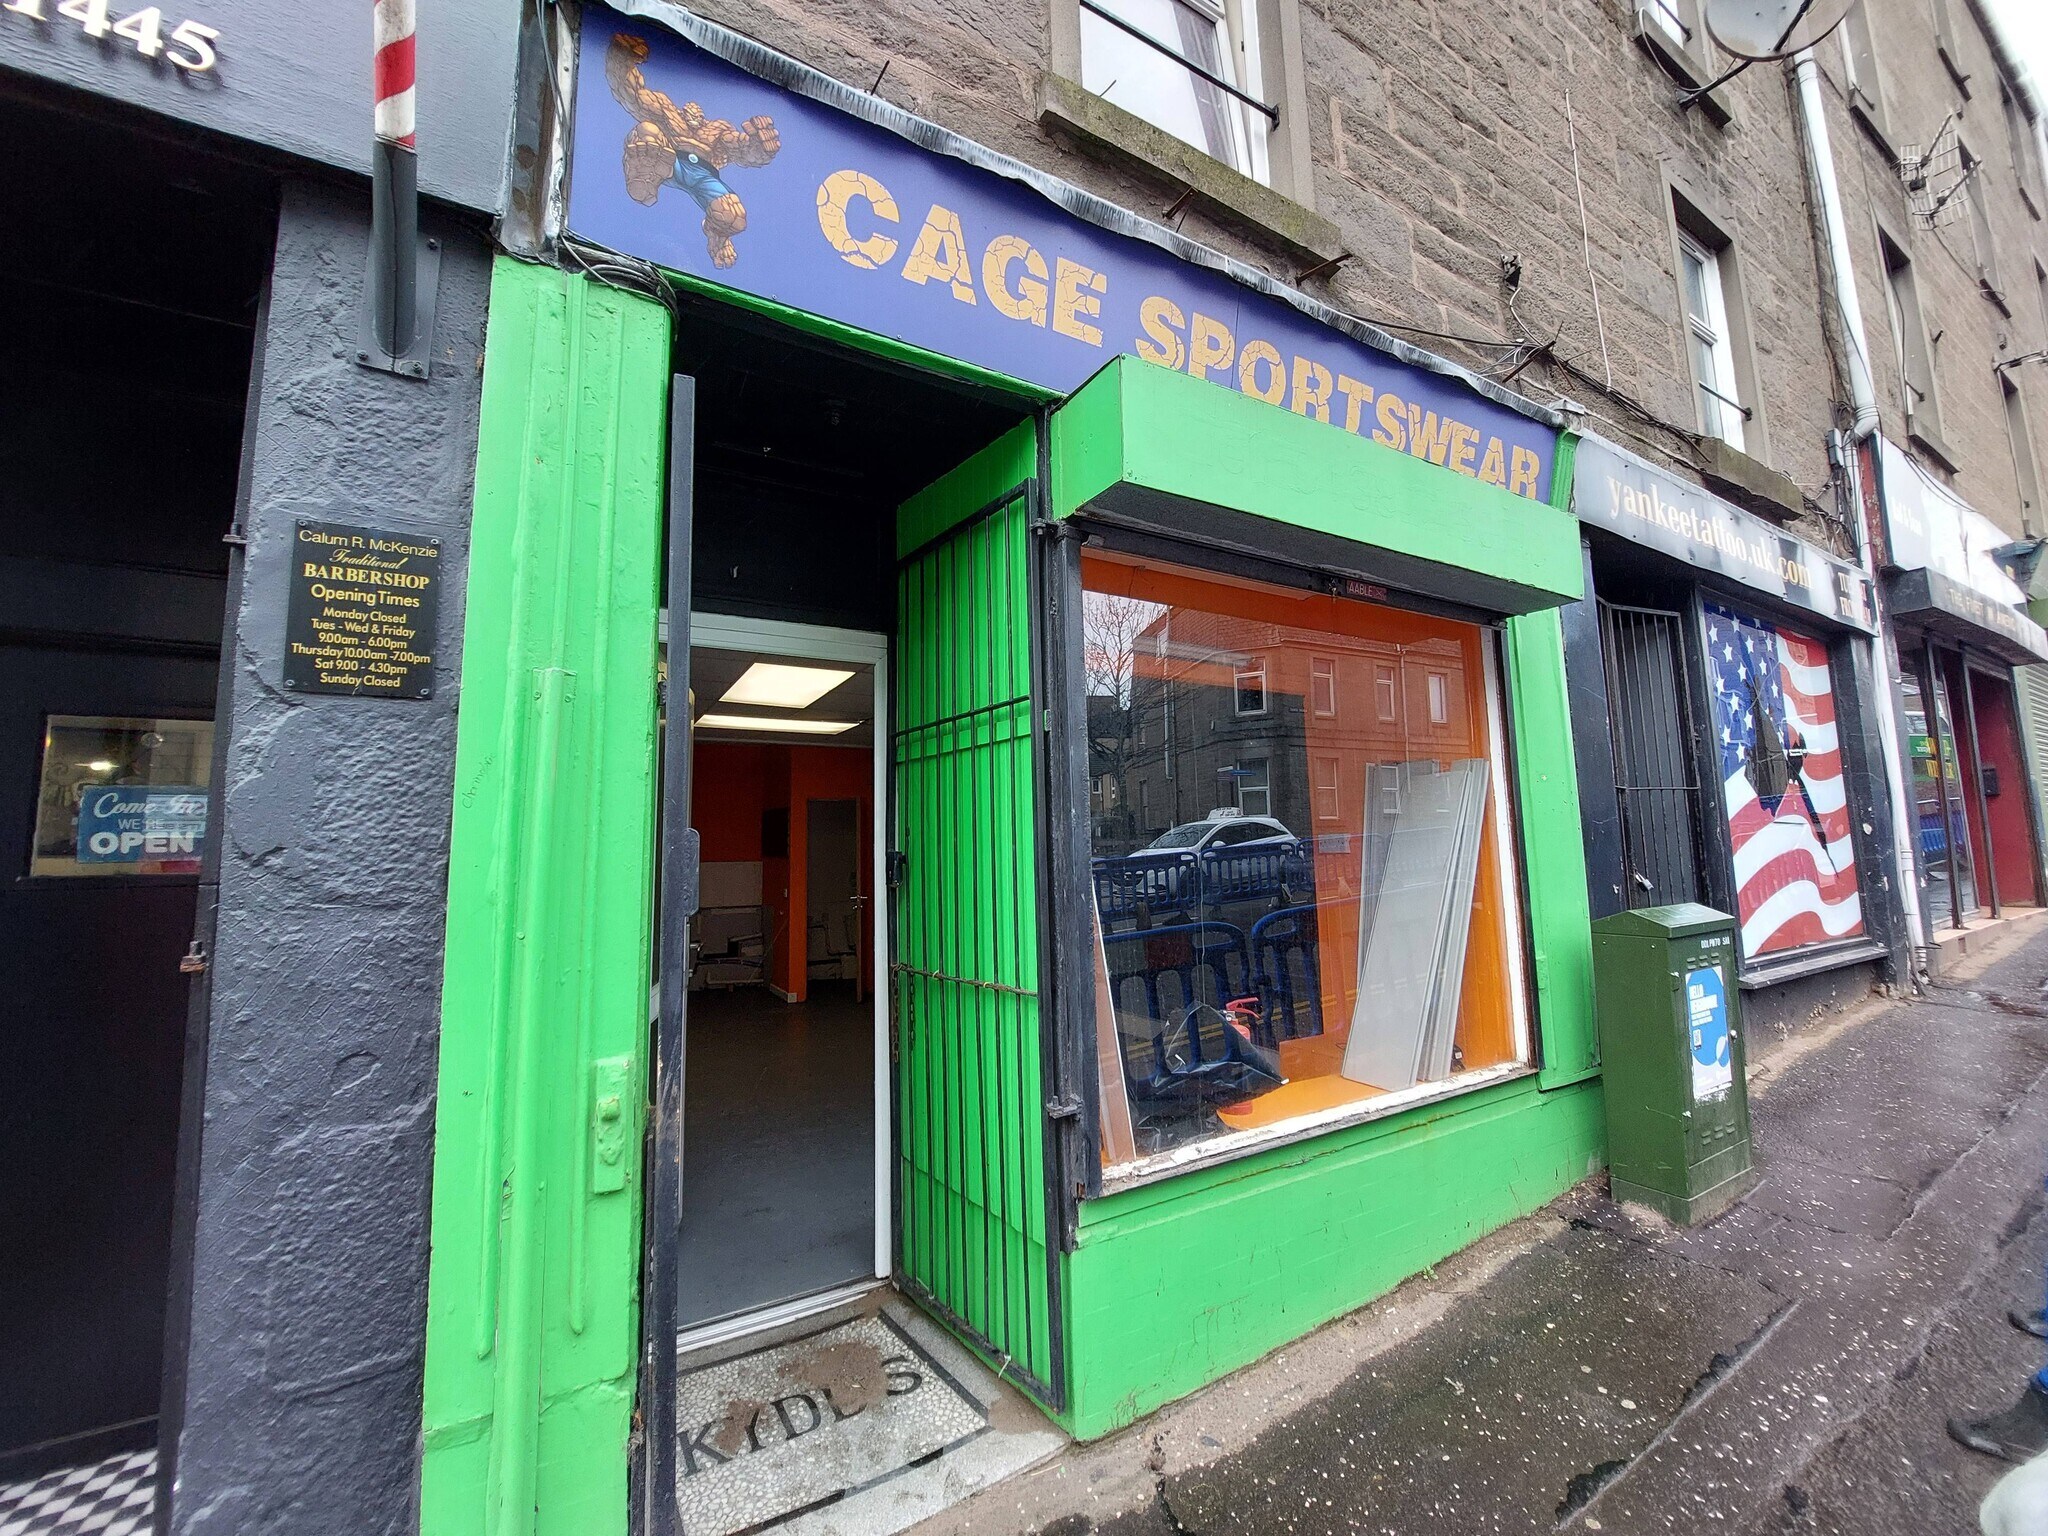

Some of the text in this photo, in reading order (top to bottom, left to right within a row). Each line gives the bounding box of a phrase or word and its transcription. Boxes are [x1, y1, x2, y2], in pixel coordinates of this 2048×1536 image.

[817, 170, 1540, 499] CAGE SPORTSWEAR
[300, 530, 437, 558] Calum R. McKenzie
[329, 549, 408, 570] Traditional
[303, 563, 430, 590] BARBERSHOP
[311, 584, 420, 608] Opening Times
[323, 607, 407, 623] Monday Closed
[311, 619, 335, 630] Tues
[345, 621, 369, 633] Wed
[371, 624, 380, 634] &
[382, 625, 416, 638] Friday
[291, 643, 344, 659] Thursday
[344, 647, 387, 660] 10.00am
[319, 633, 359, 645] 9.00am
[368, 637, 407, 650] 6.00pm
[315, 658, 334, 669] Sat
[336, 660, 359, 671] 9.00
[368, 663, 407, 675] 4.30pm
[320, 673, 401, 687] Sunday Closed
[93, 792, 158, 818] Come
[89, 831, 195, 855] OPEN
